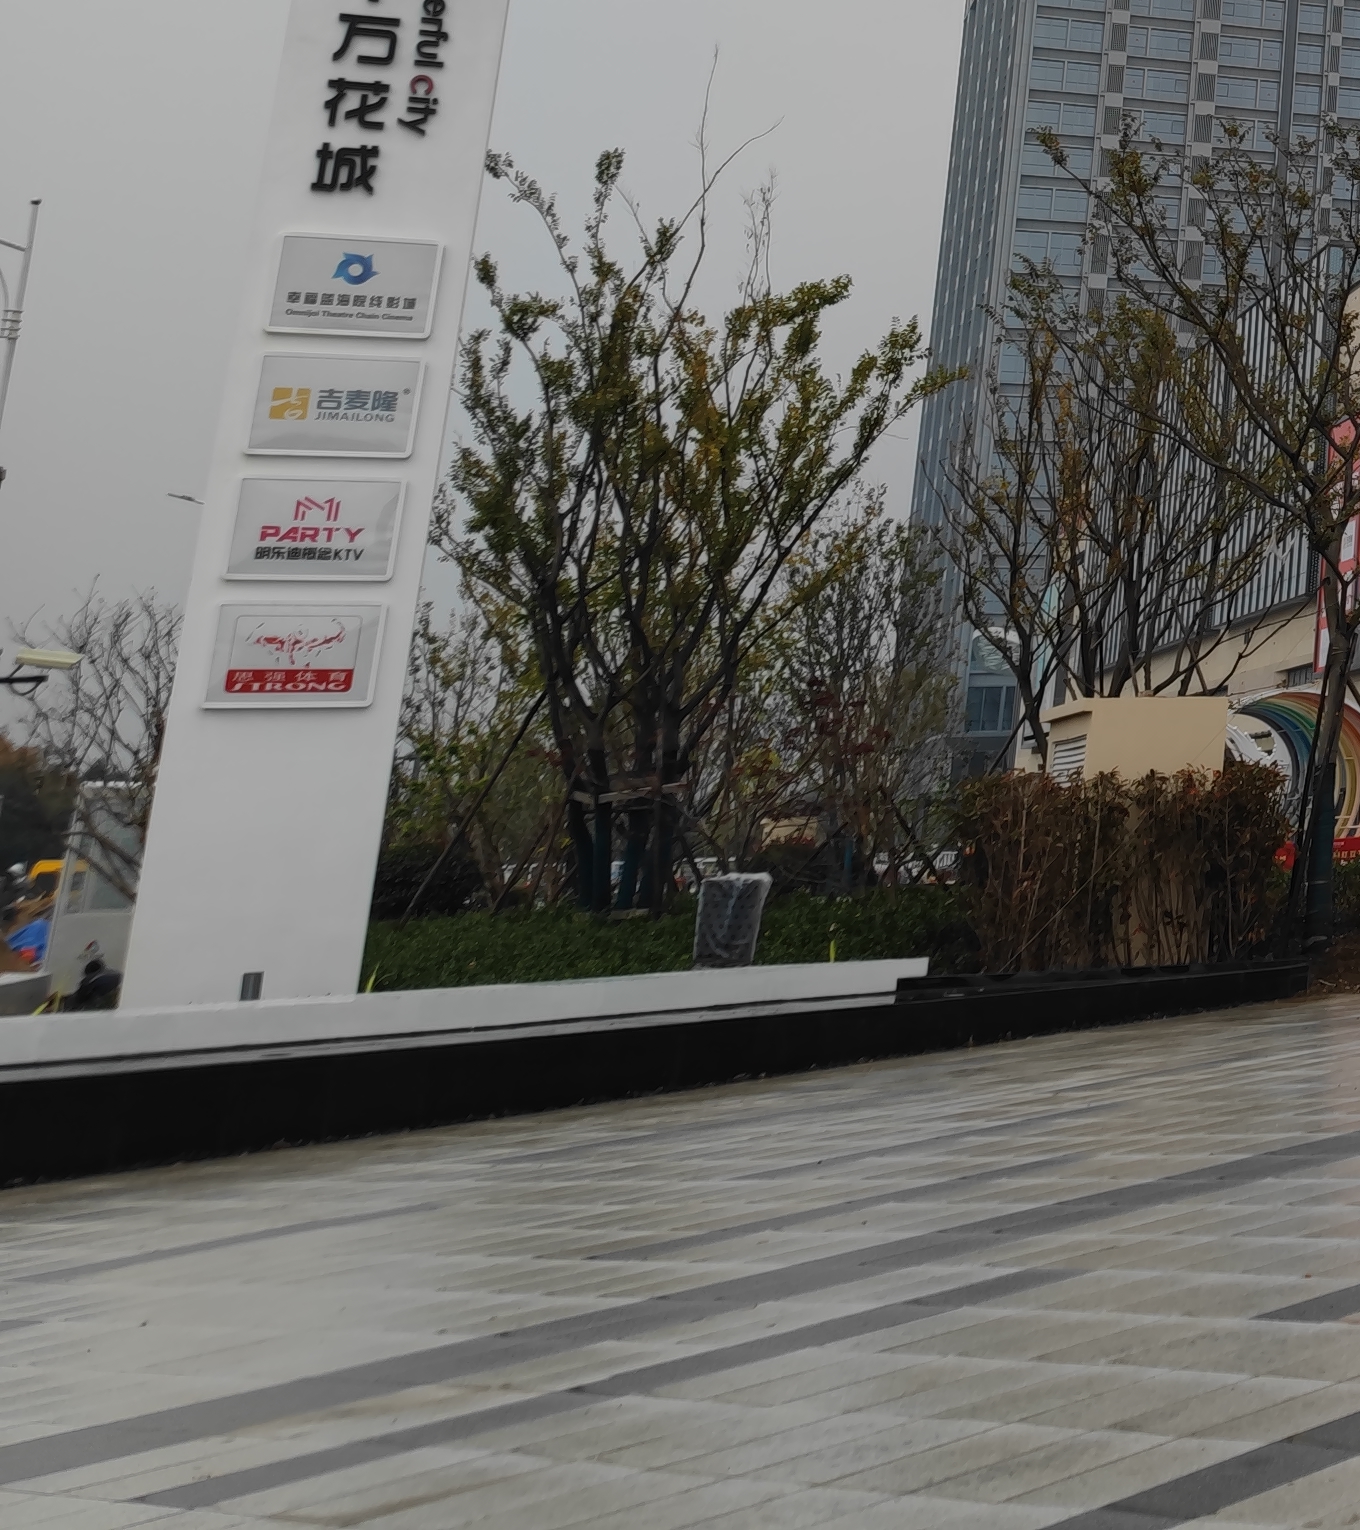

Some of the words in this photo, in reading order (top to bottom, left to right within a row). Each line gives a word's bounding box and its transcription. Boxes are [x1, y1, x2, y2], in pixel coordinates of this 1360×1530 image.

[396, 74, 440, 137] City
[316, 388, 398, 412] 吉麦隆
[314, 411, 395, 422] JIMAILONG
[259, 525, 365, 543] PARTY
[230, 682, 346, 691] STRONG
